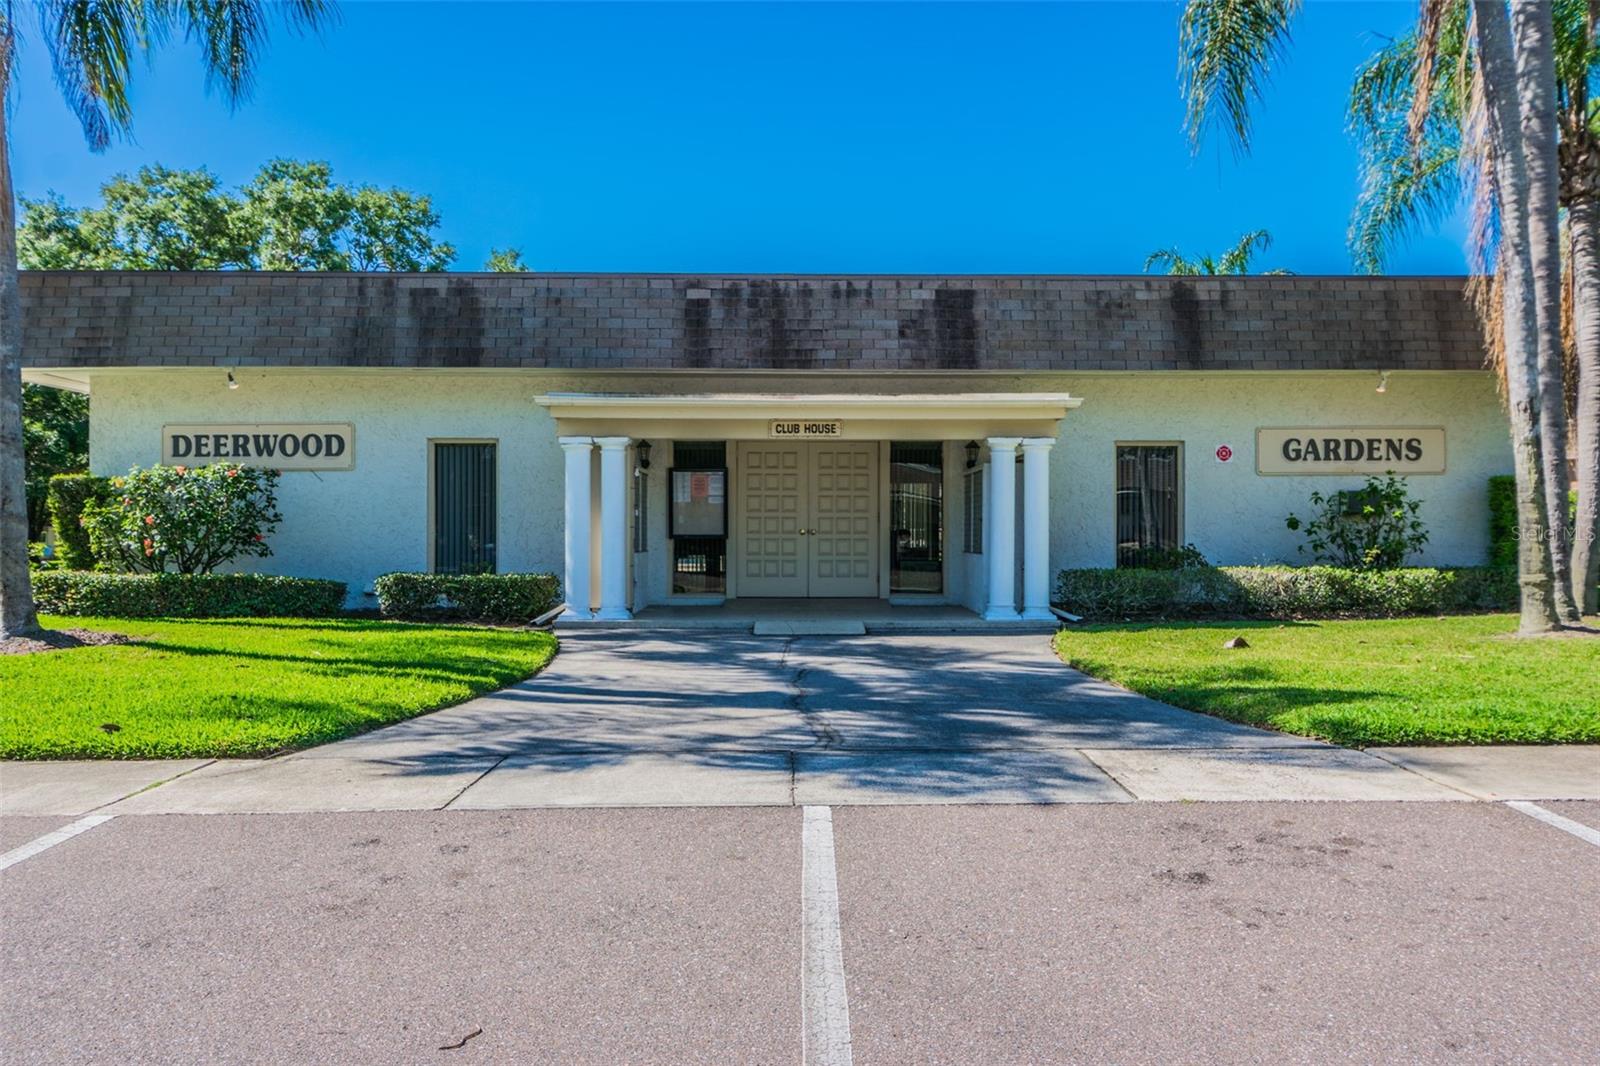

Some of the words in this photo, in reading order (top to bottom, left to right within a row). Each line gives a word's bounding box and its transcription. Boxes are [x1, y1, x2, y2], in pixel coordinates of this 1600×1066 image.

[775, 423, 800, 434] CLUB
[804, 423, 837, 434] HOUSE
[171, 433, 345, 458] DEERWOOD
[1282, 437, 1423, 462] GARDENS
